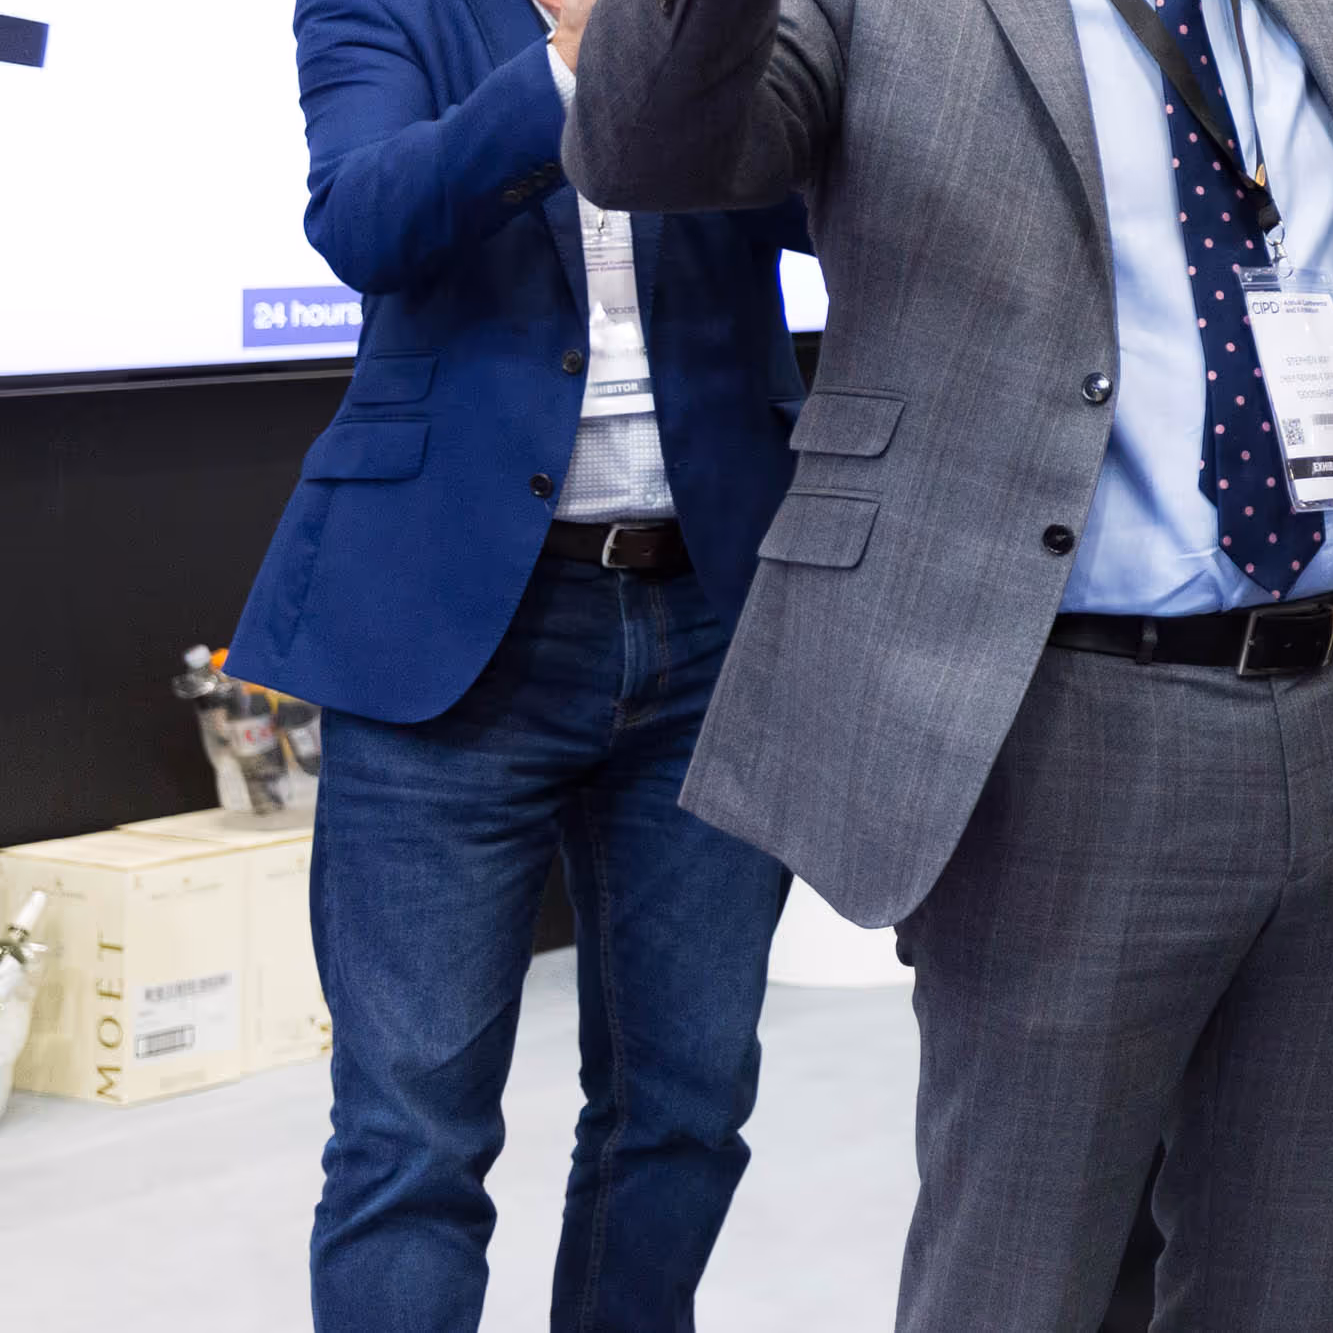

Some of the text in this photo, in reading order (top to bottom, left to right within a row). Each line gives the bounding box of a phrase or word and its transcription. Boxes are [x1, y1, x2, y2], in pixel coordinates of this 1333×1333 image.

[253, 299, 363, 330] 24 hours
[1252, 301, 1280, 315] CIPD
